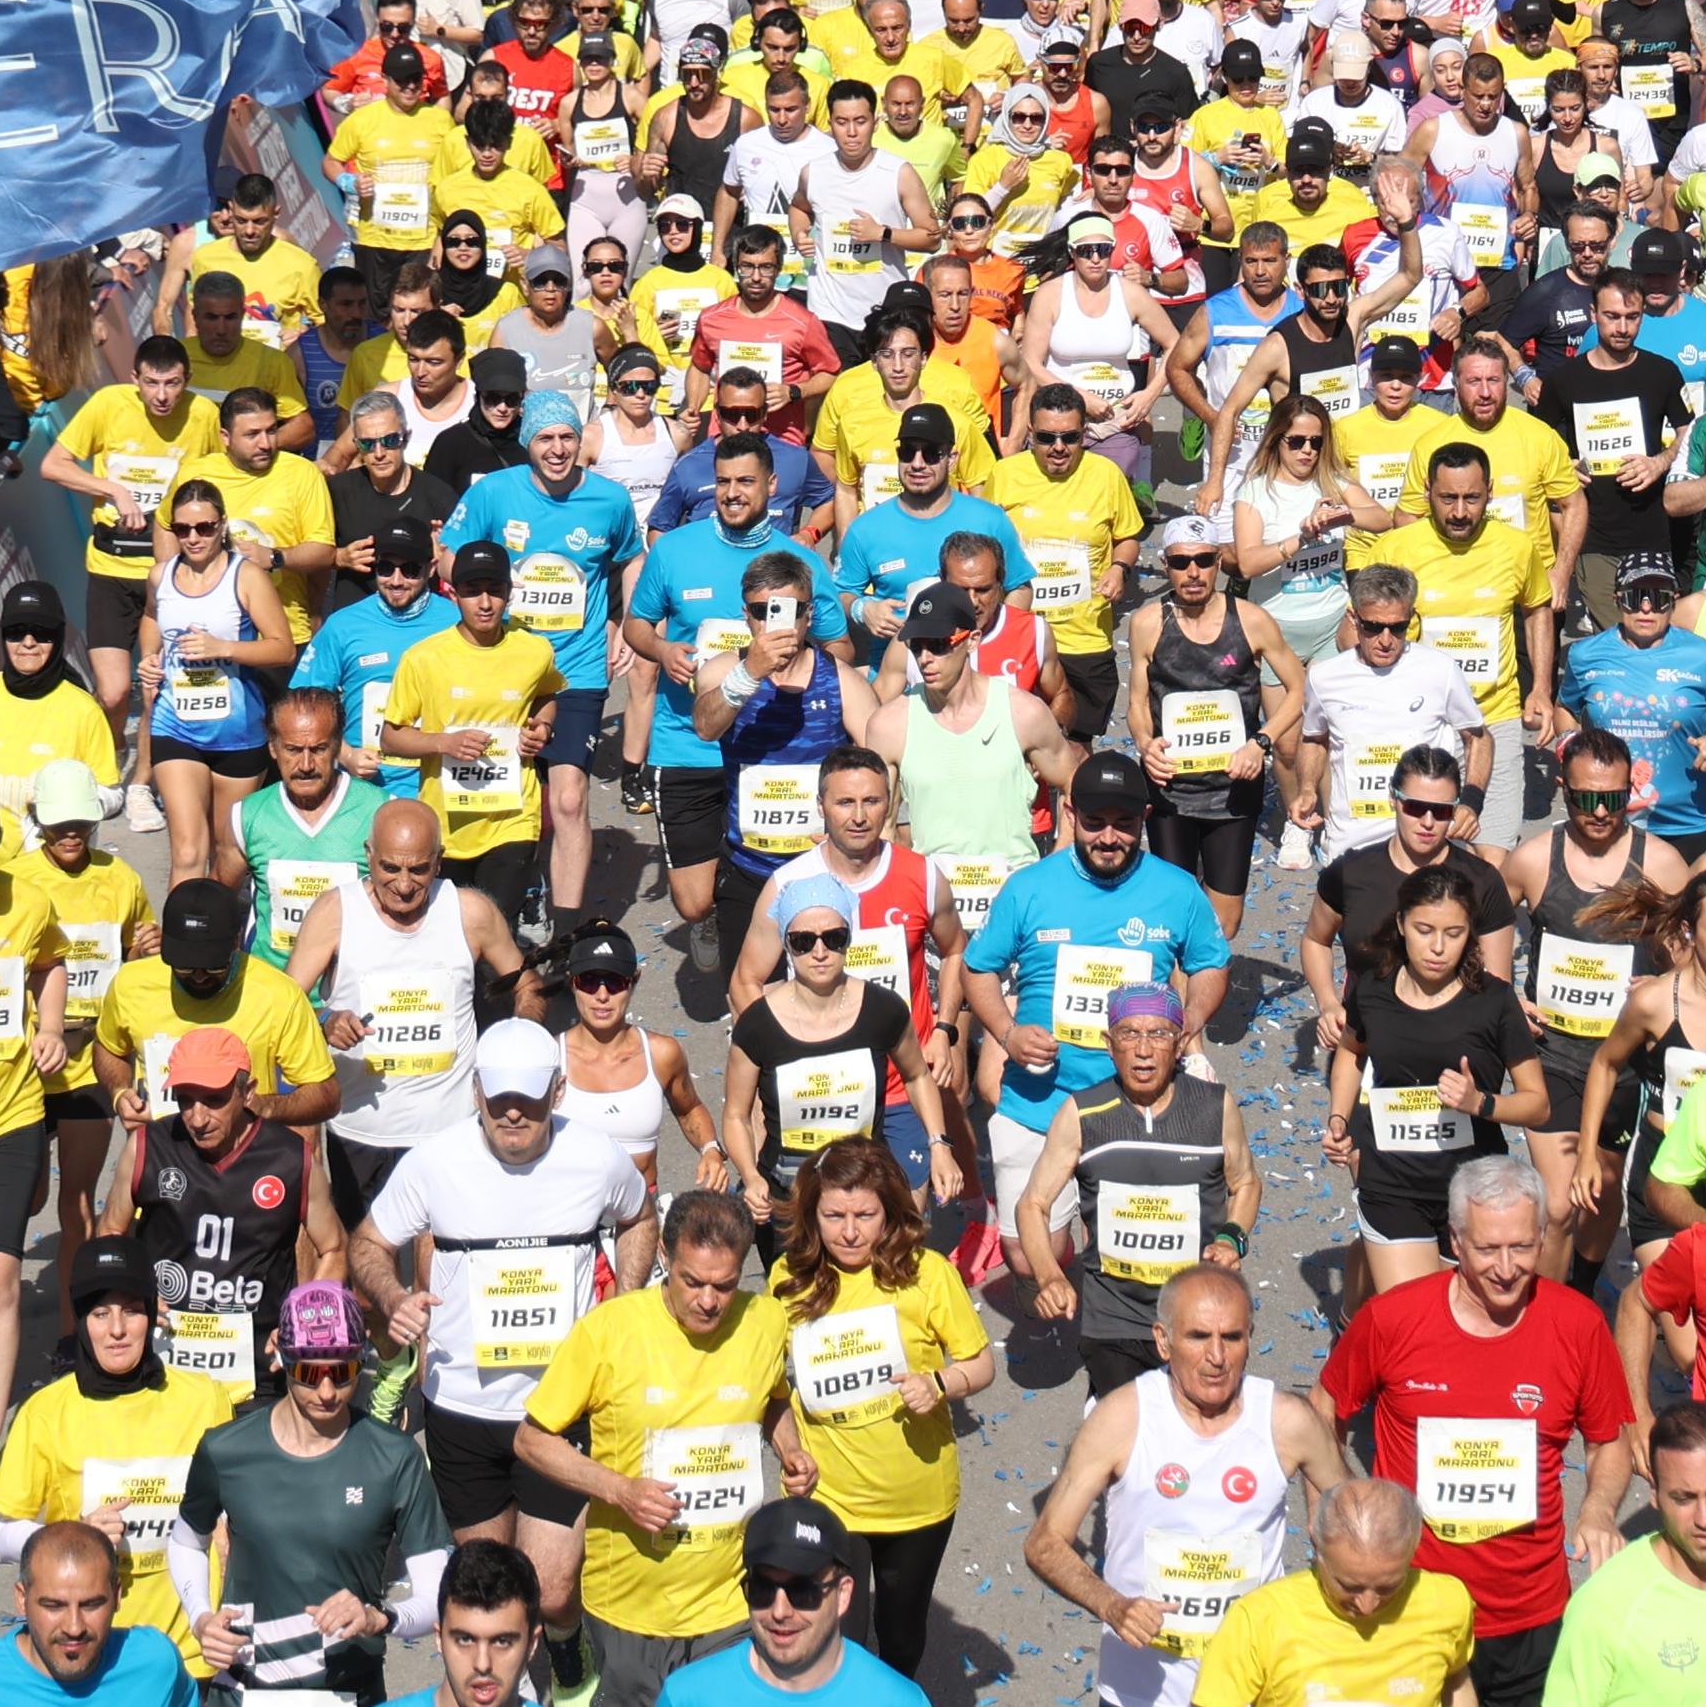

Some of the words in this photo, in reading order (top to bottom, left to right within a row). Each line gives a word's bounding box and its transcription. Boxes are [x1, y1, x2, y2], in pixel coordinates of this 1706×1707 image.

[1638, 41, 1677, 53] TEMPO
[1628, 89, 1668, 101] 12439
[381, 210, 419, 222] 11904
[832, 242, 871, 255] 10197
[1587, 436, 1633, 452] 11626
[1286, 549, 1339, 573] 43998
[521, 591, 573, 605] 13108
[1034, 583, 1081, 600] 0967
[1656, 669, 1678, 683] SK
[175, 697, 227, 710] 11258
[1177, 730, 1231, 746] 11966
[451, 766, 508, 781] 12462
[1359, 776, 1391, 789] 112
[753, 810, 809, 824] 11875
[66, 970, 97, 987] 2117
[1551, 985, 1614, 1006] 11894
[376, 1024, 442, 1043] 11286
[799, 1104, 859, 1120] 11192
[1390, 1122, 1456, 1140] 11525
[196, 1214, 234, 1261] 01
[495, 1238, 548, 1248] AONIJIE
[1113, 1231, 1185, 1250] 10081
[189, 1273, 264, 1306] Beta
[490, 1307, 556, 1328] 11851
[166, 1350, 236, 1369] 12201
[813, 1364, 893, 1398] 10879
[1452, 1440, 1498, 1451] KONYA
[1435, 1456, 1516, 1469] MARATONU
[1436, 1482, 1516, 1504] 11954
